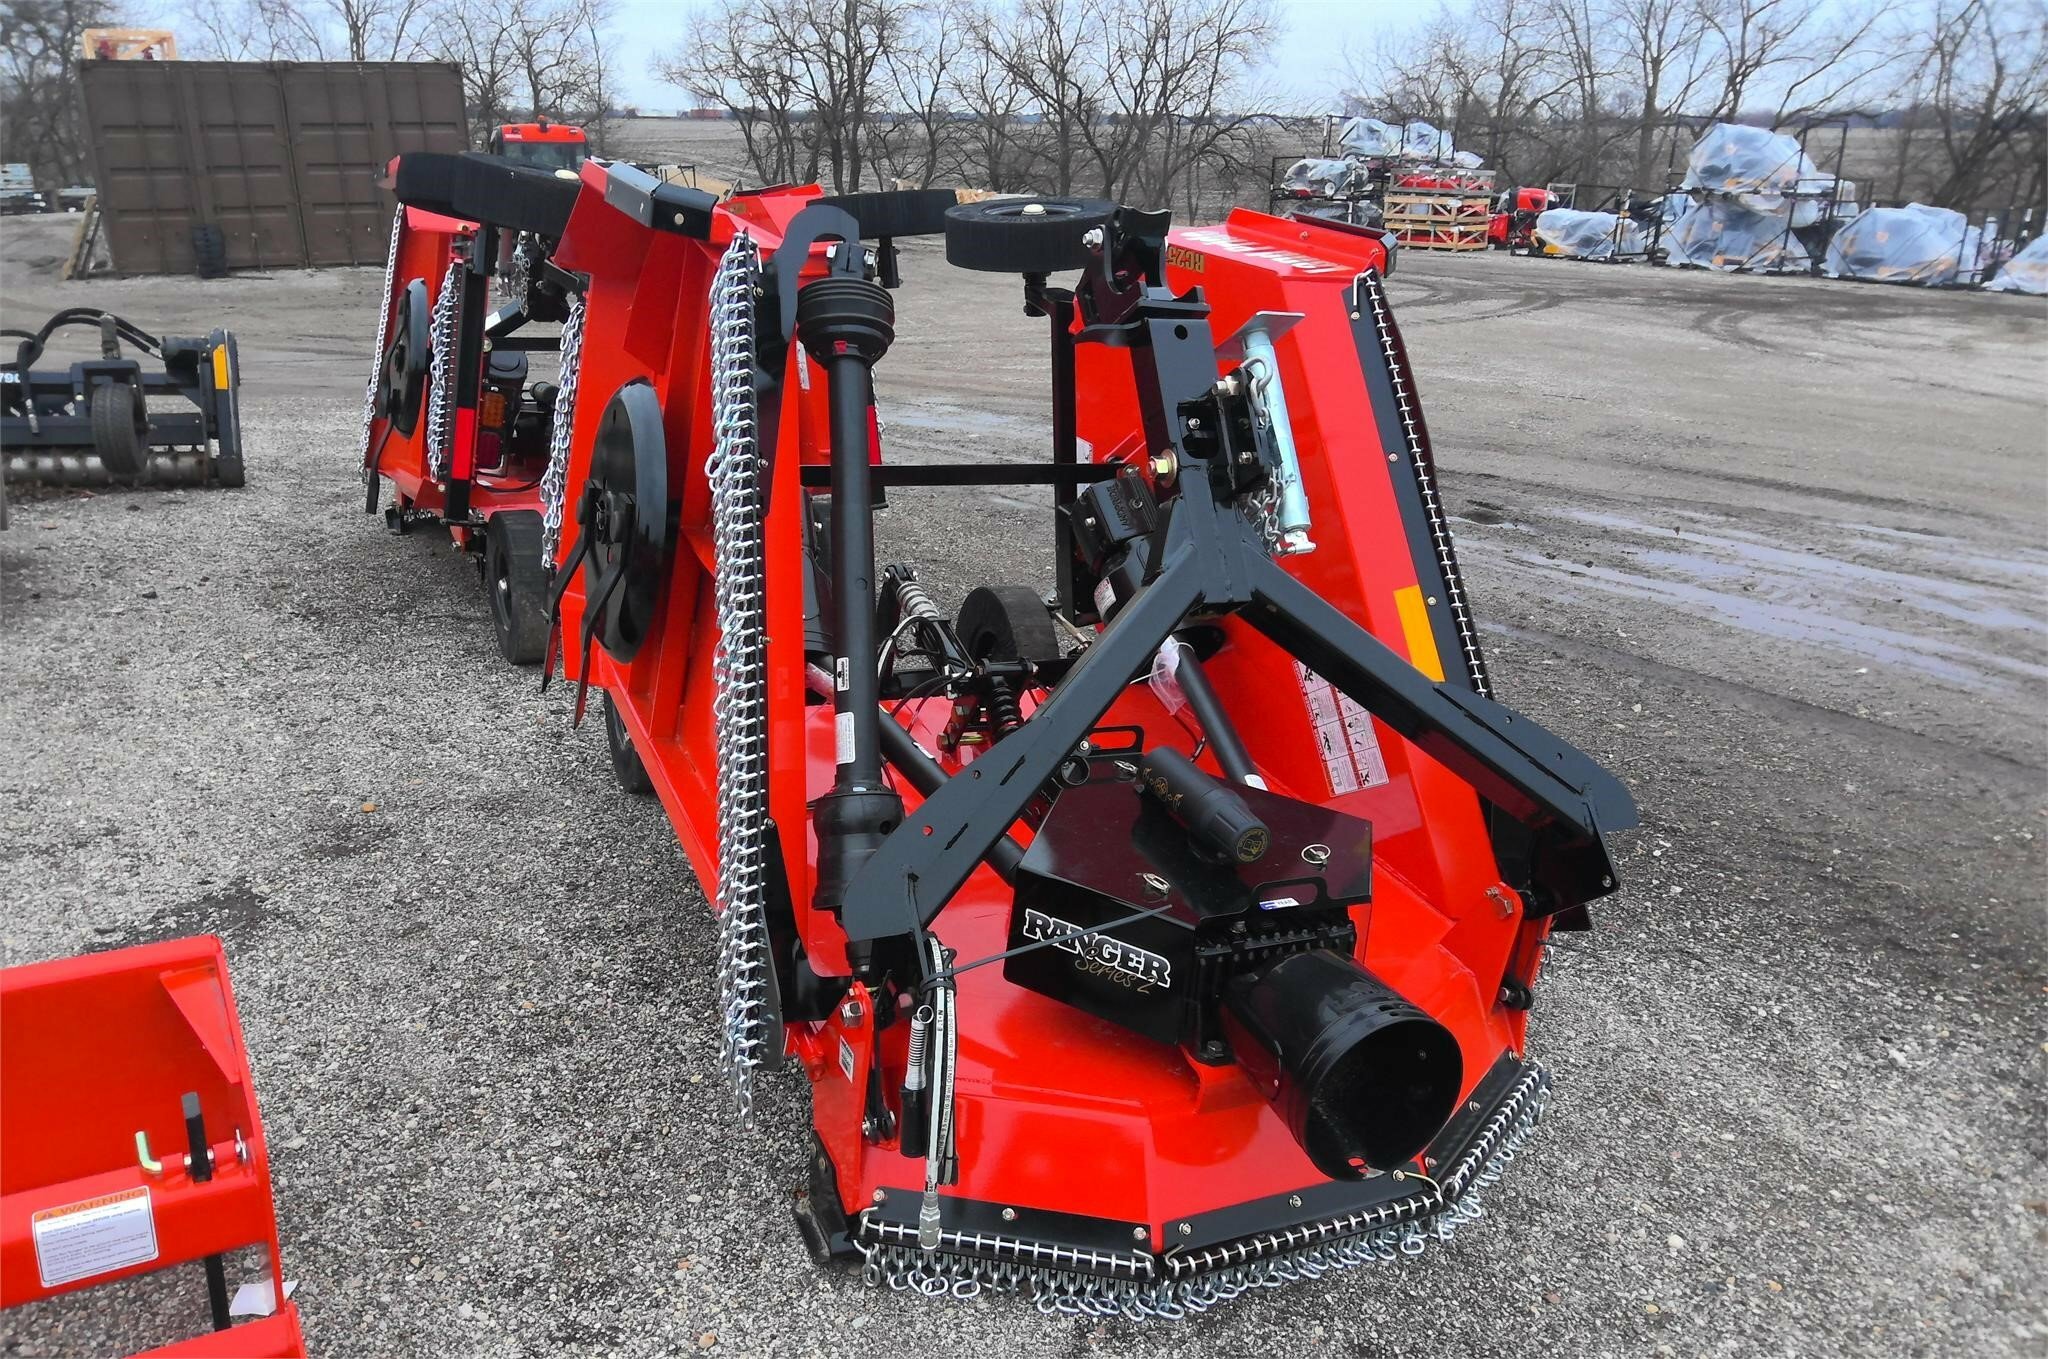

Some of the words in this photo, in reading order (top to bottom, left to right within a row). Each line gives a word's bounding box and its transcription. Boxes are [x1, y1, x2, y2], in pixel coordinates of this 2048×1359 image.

[1023, 908, 1171, 988] RANGER
[1075, 946, 1137, 988] Series
[1137, 975, 1159, 994] 2
